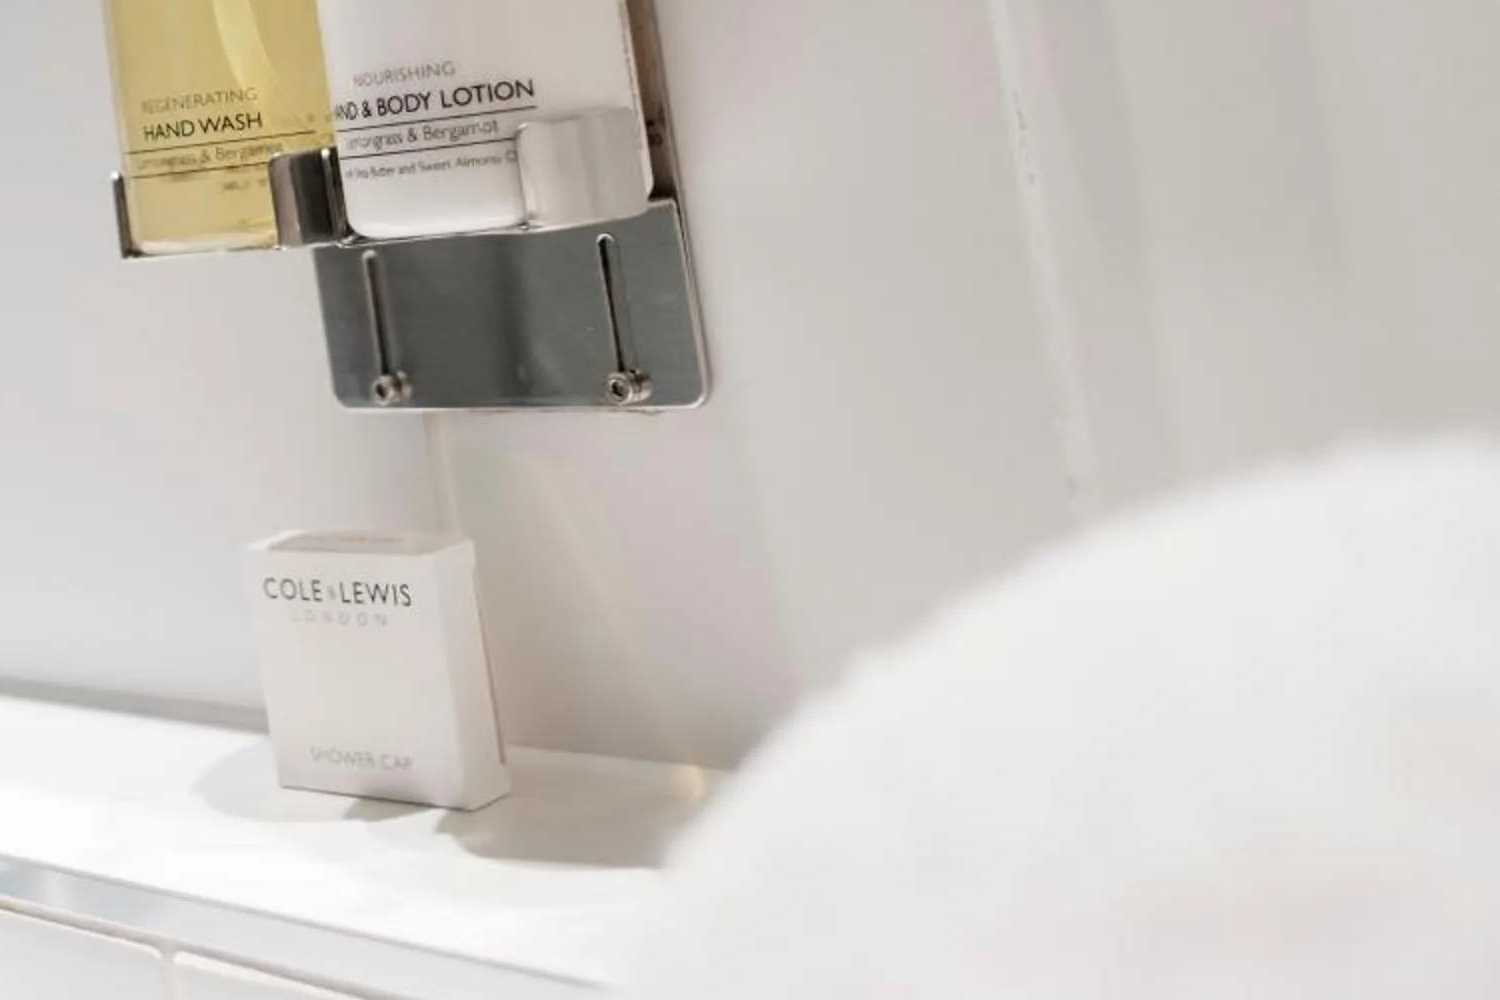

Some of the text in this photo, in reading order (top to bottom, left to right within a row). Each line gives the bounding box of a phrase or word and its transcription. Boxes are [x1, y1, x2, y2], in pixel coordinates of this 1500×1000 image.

[353, 60, 456, 87] NOURISHING
[141, 86, 258, 115] REGENERATING
[361, 99, 373, 118] &
[376, 91, 432, 117] BODY
[440, 78, 536, 108] LOTION
[142, 111, 263, 143] HAND WASH
[407, 127, 418, 143] &
[422, 119, 498, 142] Bergamot
[262, 577, 324, 602] COLE
[339, 581, 413, 607] LEWIS
[308, 745, 376, 768] SHOWER
